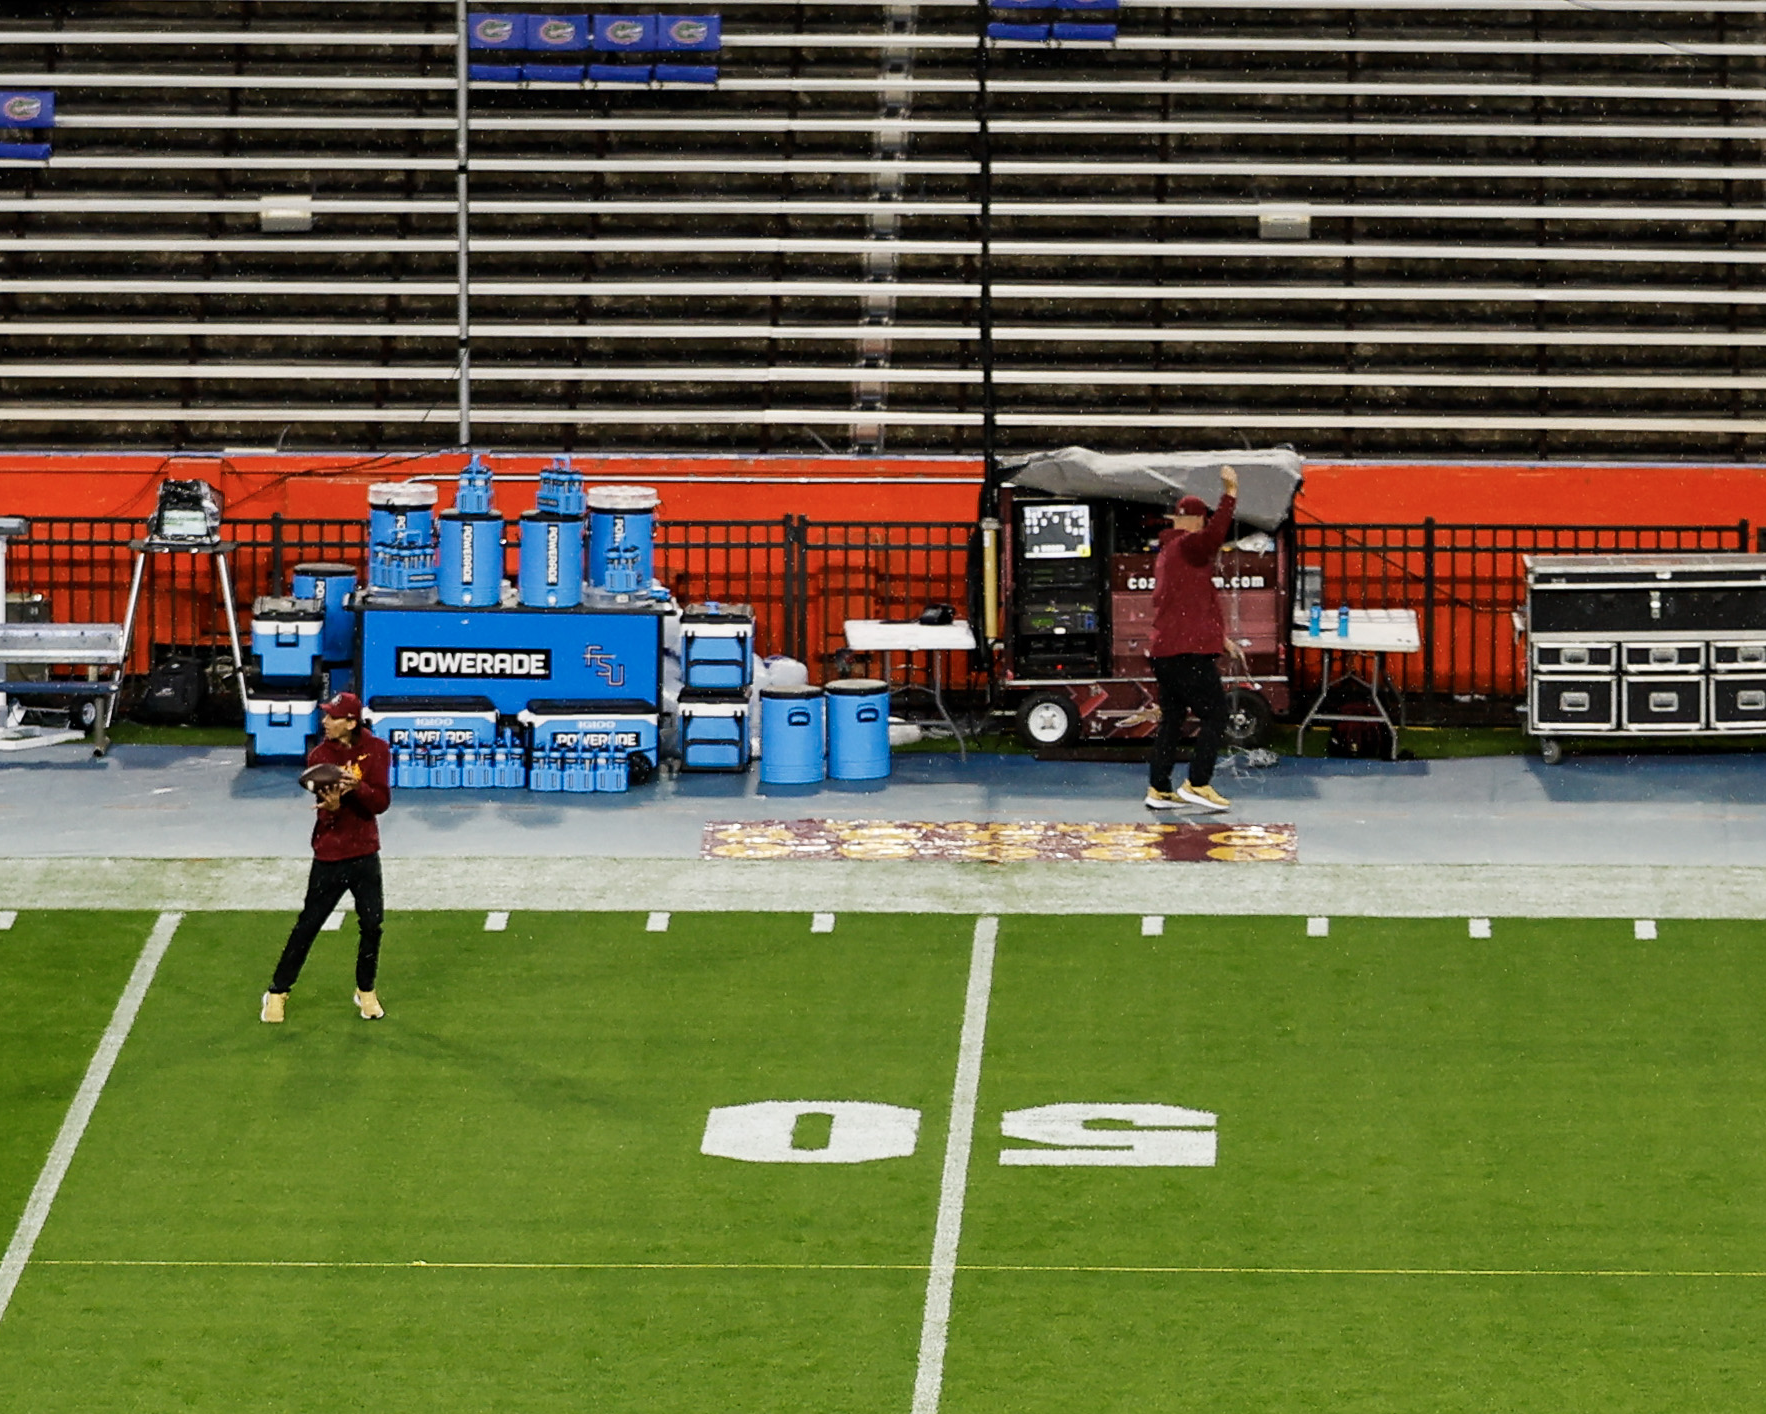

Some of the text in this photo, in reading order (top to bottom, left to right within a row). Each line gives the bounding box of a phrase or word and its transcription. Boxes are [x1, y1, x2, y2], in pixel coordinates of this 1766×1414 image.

[463, 525, 473, 583] POWERADE
[548, 526, 558, 583] POWERADE
[401, 651, 548, 675] POWERADE
[582, 645, 624, 686] FSU
[700, 1100, 1219, 1167] 50
